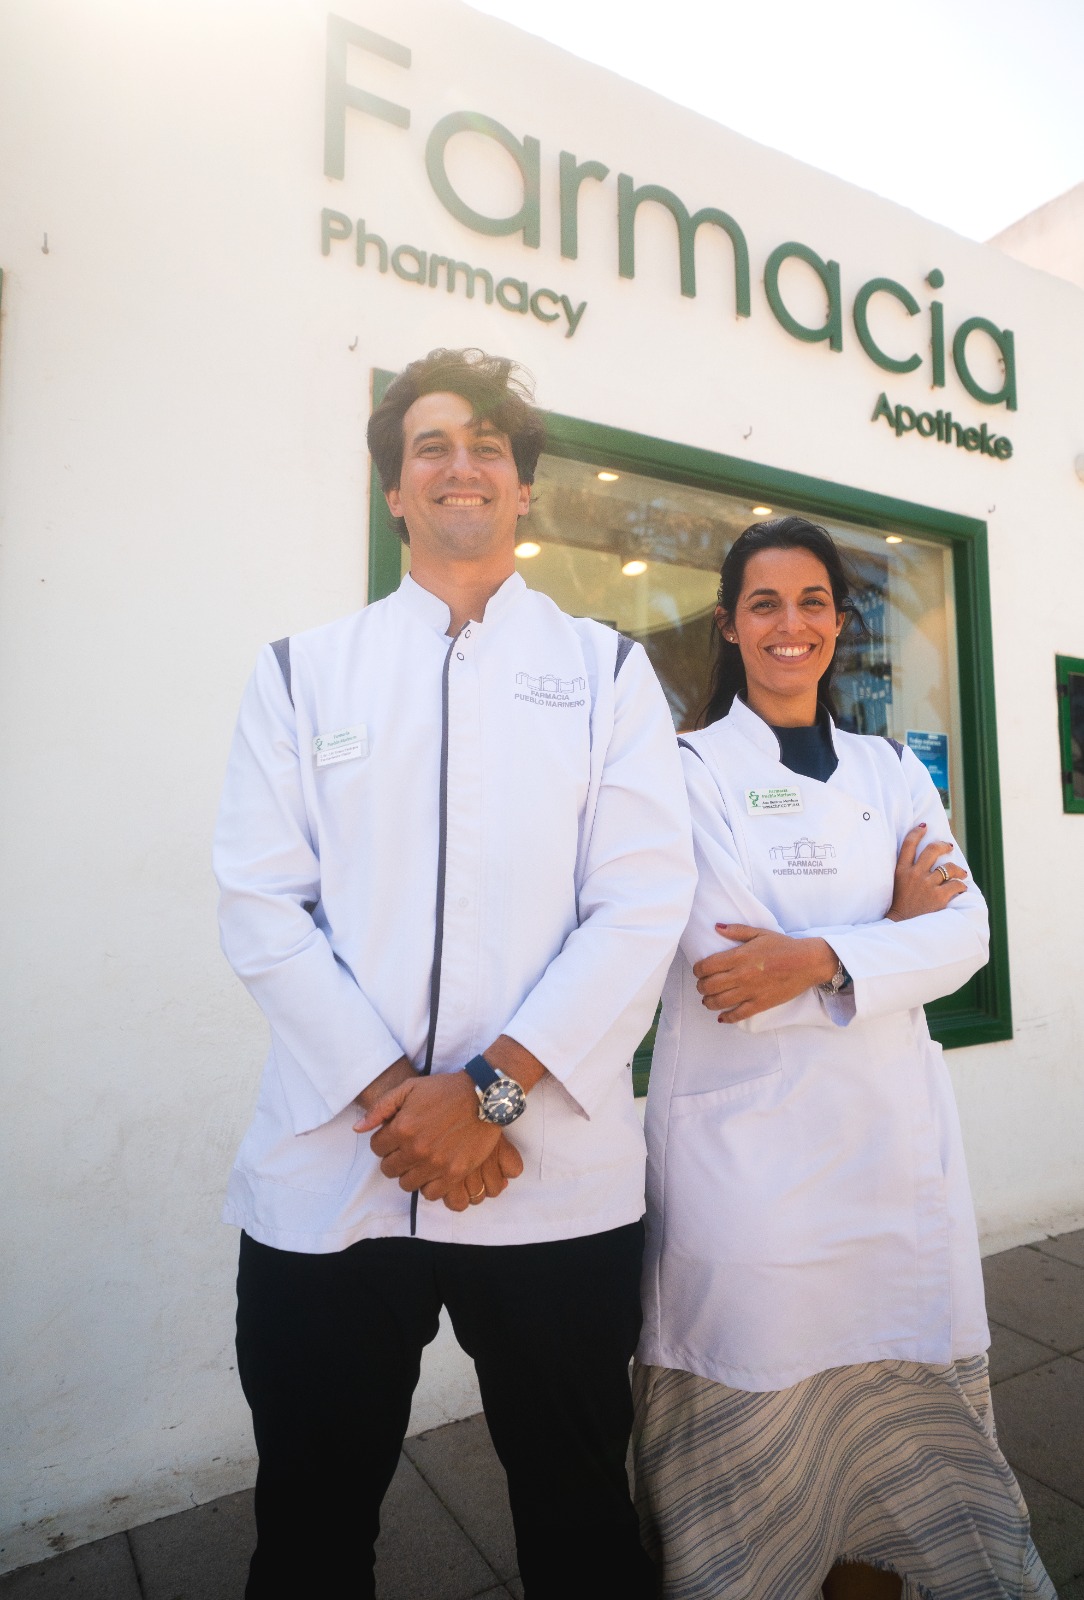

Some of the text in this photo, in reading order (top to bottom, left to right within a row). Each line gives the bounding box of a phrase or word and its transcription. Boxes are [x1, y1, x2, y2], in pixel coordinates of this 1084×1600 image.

[323, 12, 1018, 411] Farmacia
[321, 207, 587, 338] Pharmacy
[871, 392, 1013, 460] Apotheke
[514, 693, 585, 708] PUEBLO MARINERO
[530, 690, 569, 700] FARMACIA
[772, 867, 838, 876] PUEBLO MARINERO
